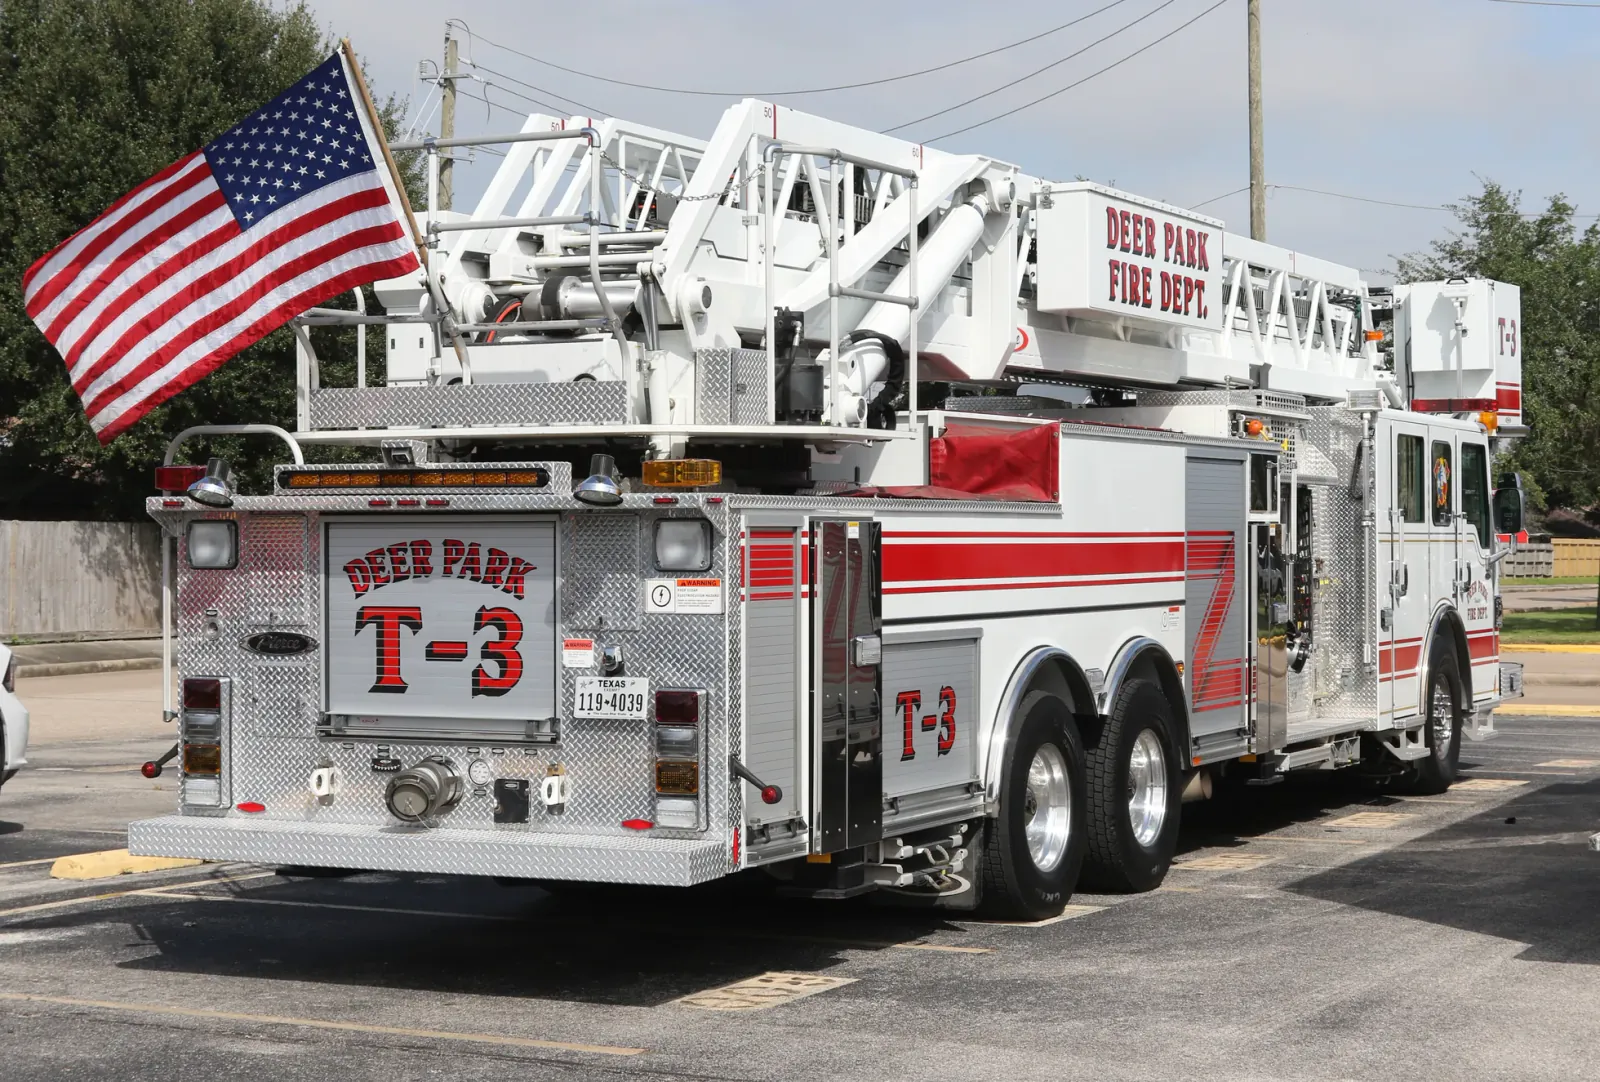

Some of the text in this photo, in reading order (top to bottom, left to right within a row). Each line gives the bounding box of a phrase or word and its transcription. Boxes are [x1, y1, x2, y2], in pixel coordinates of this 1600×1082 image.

[763, 106, 773, 119] 50
[1106, 206, 1209, 272] DEER PARK
[1109, 259, 1208, 319] FIRE DEPT.
[1498, 317, 1516, 357] T-3
[343, 539, 537, 600] DEER PARK
[1467, 607, 1476, 620] FIRE
[355, 604, 524, 699] T-3
[598, 680, 626, 688] TEXAS
[895, 684, 956, 762] T-3
